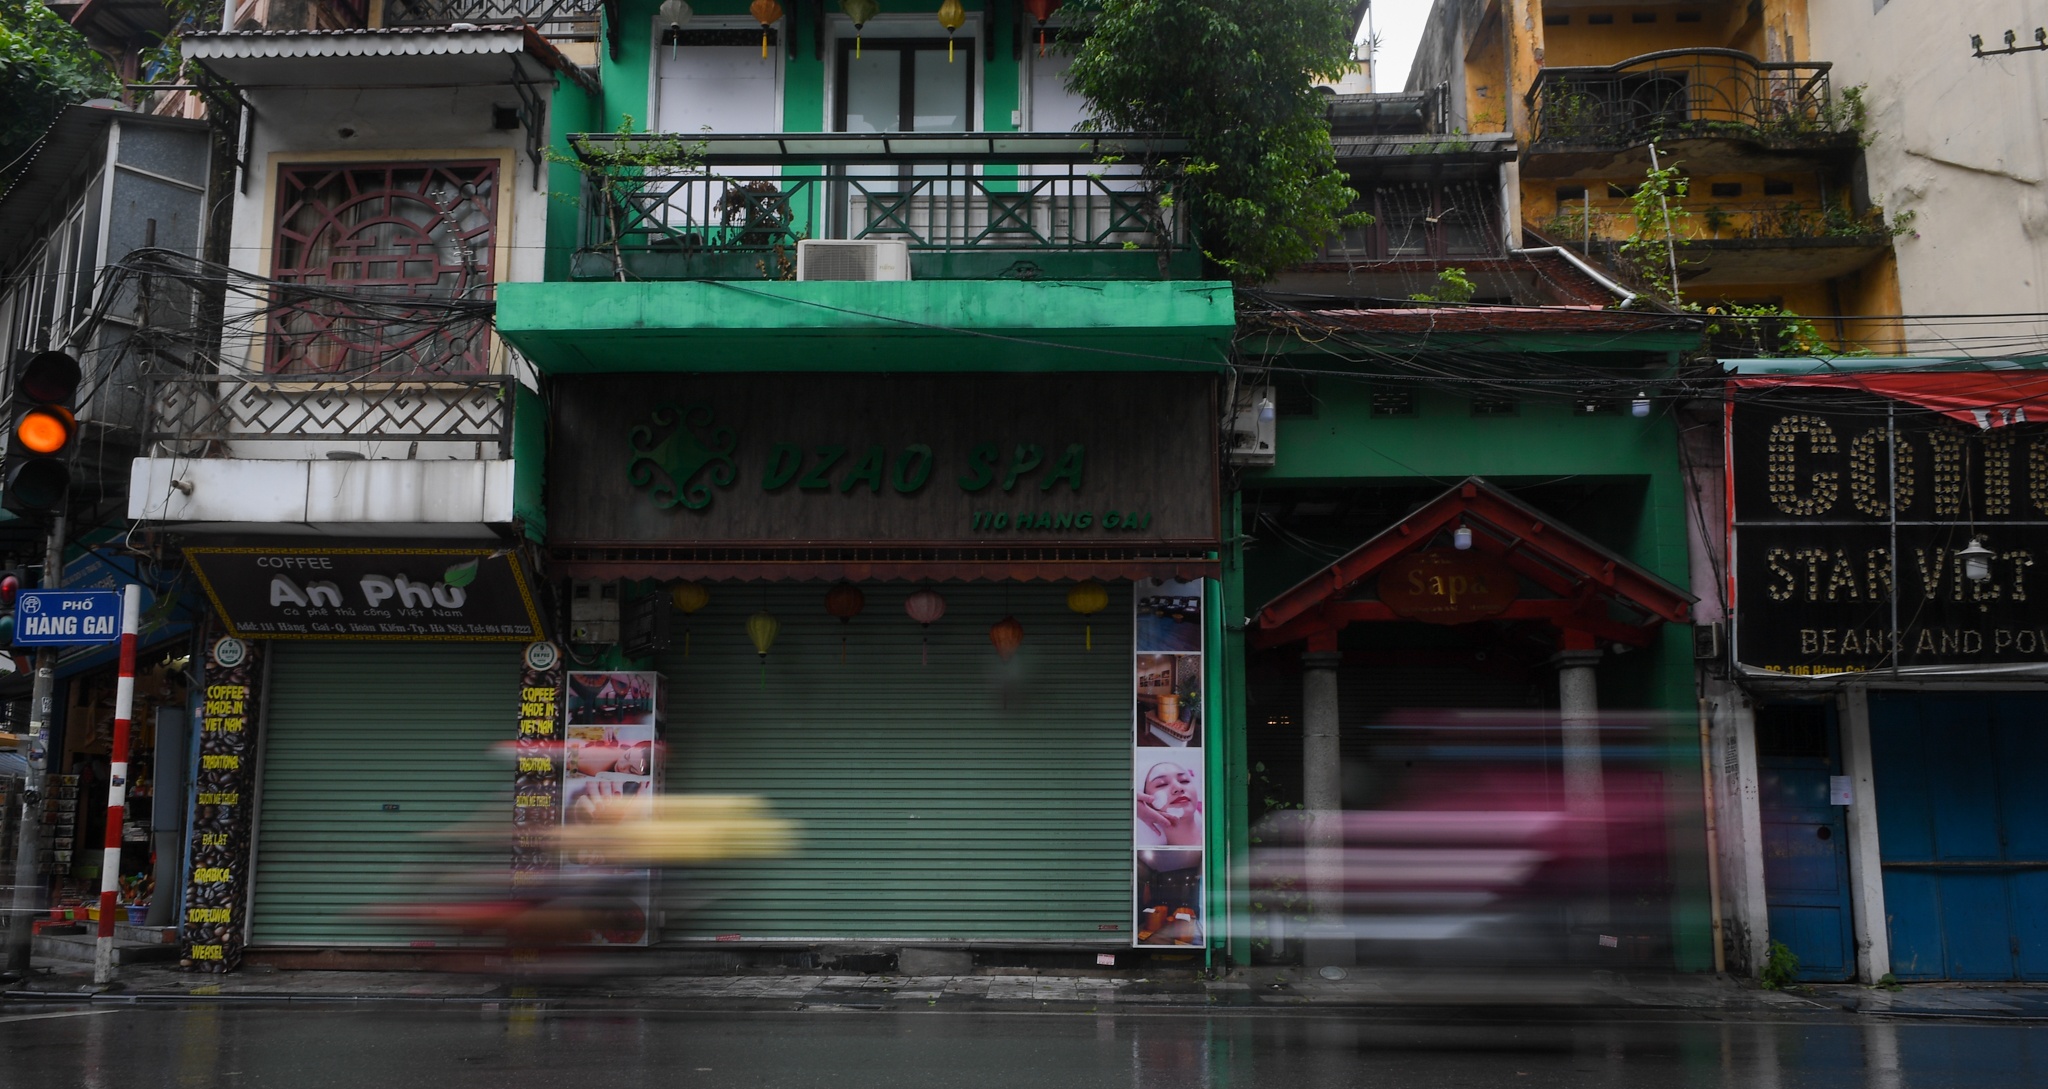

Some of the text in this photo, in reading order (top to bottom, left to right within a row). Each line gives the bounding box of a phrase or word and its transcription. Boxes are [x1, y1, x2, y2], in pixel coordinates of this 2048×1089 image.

[762, 443, 1085, 493] DZAO SPA
[972, 511, 1151, 530] 110 HANG GAI
[257, 557, 333, 570] COFFEE
[1767, 548, 1898, 601] STAR
[270, 575, 343, 608] An
[1408, 569, 1489, 604] Sapa
[62, 597, 95, 610] PHỐ
[307, 607, 329, 618] phê
[363, 607, 392, 618] công
[397, 608, 424, 618] Việt
[433, 608, 463, 617] Nam
[25, 612, 115, 635] HÀNG GAI
[277, 622, 308, 633] Hàng
[349, 623, 376, 632] Hoàn
[429, 623, 445, 633] Hà
[1916, 628, 1982, 654] AND
[207, 685, 245, 700] COFFEE
[522, 687, 555, 703] COFFEE
[206, 701, 244, 716] MADE IN
[521, 702, 555, 717] MADE IN
[224, 717, 243, 732] NAM
[537, 719, 554, 735] NAM
[194, 868, 230, 883] ARABICA
[191, 945, 224, 960] WEASEL
